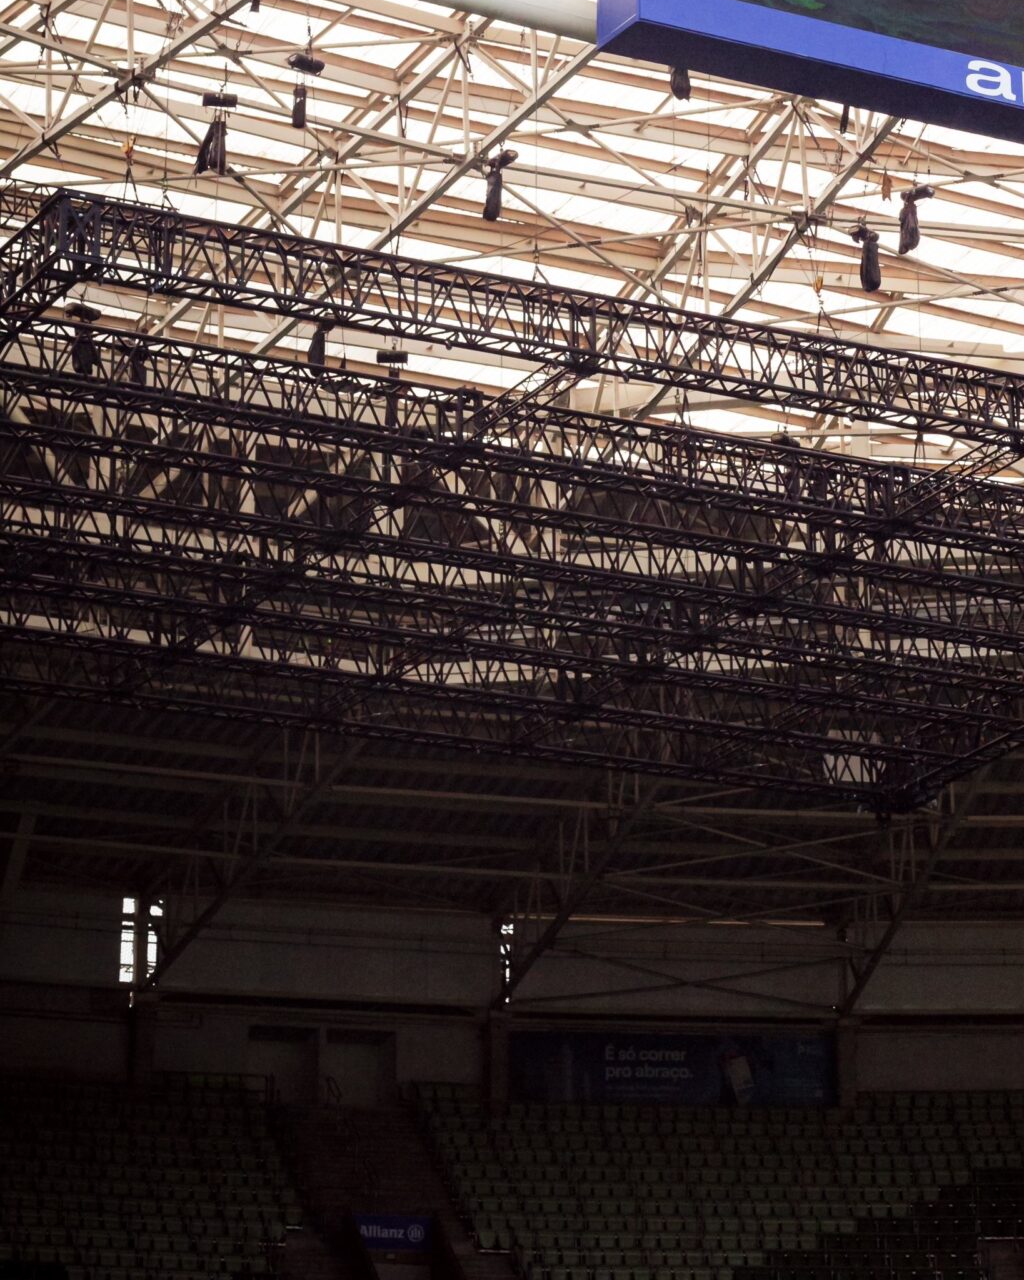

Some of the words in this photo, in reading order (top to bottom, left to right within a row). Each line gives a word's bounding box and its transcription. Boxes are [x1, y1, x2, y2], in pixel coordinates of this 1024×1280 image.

[618, 1045, 636, 1061] só
[604, 1066, 632, 1081] pro
[359, 1224, 405, 1239] Allianz
